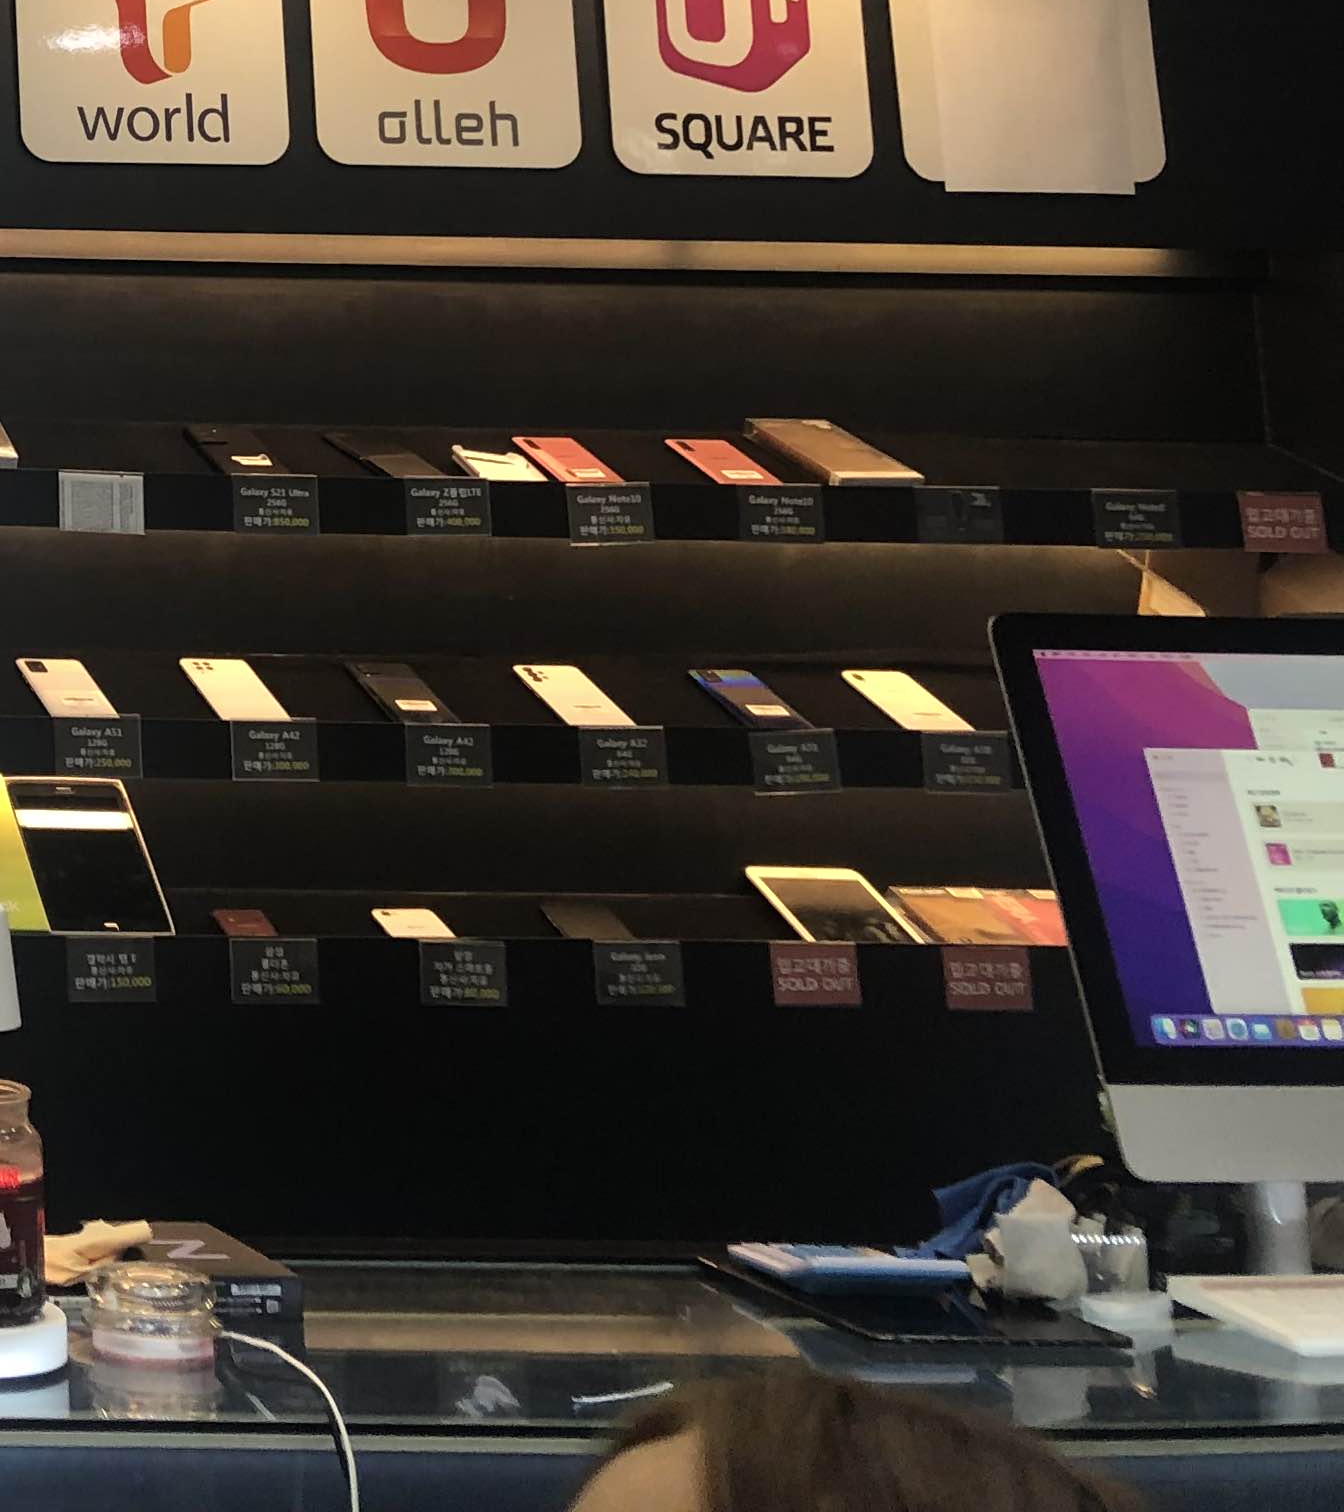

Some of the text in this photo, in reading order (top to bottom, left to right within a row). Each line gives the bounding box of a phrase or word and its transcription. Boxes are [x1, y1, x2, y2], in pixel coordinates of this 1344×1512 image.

[77, 92, 231, 147] world
[377, 109, 520, 150] olleh
[654, 110, 835, 159] SQUARE
